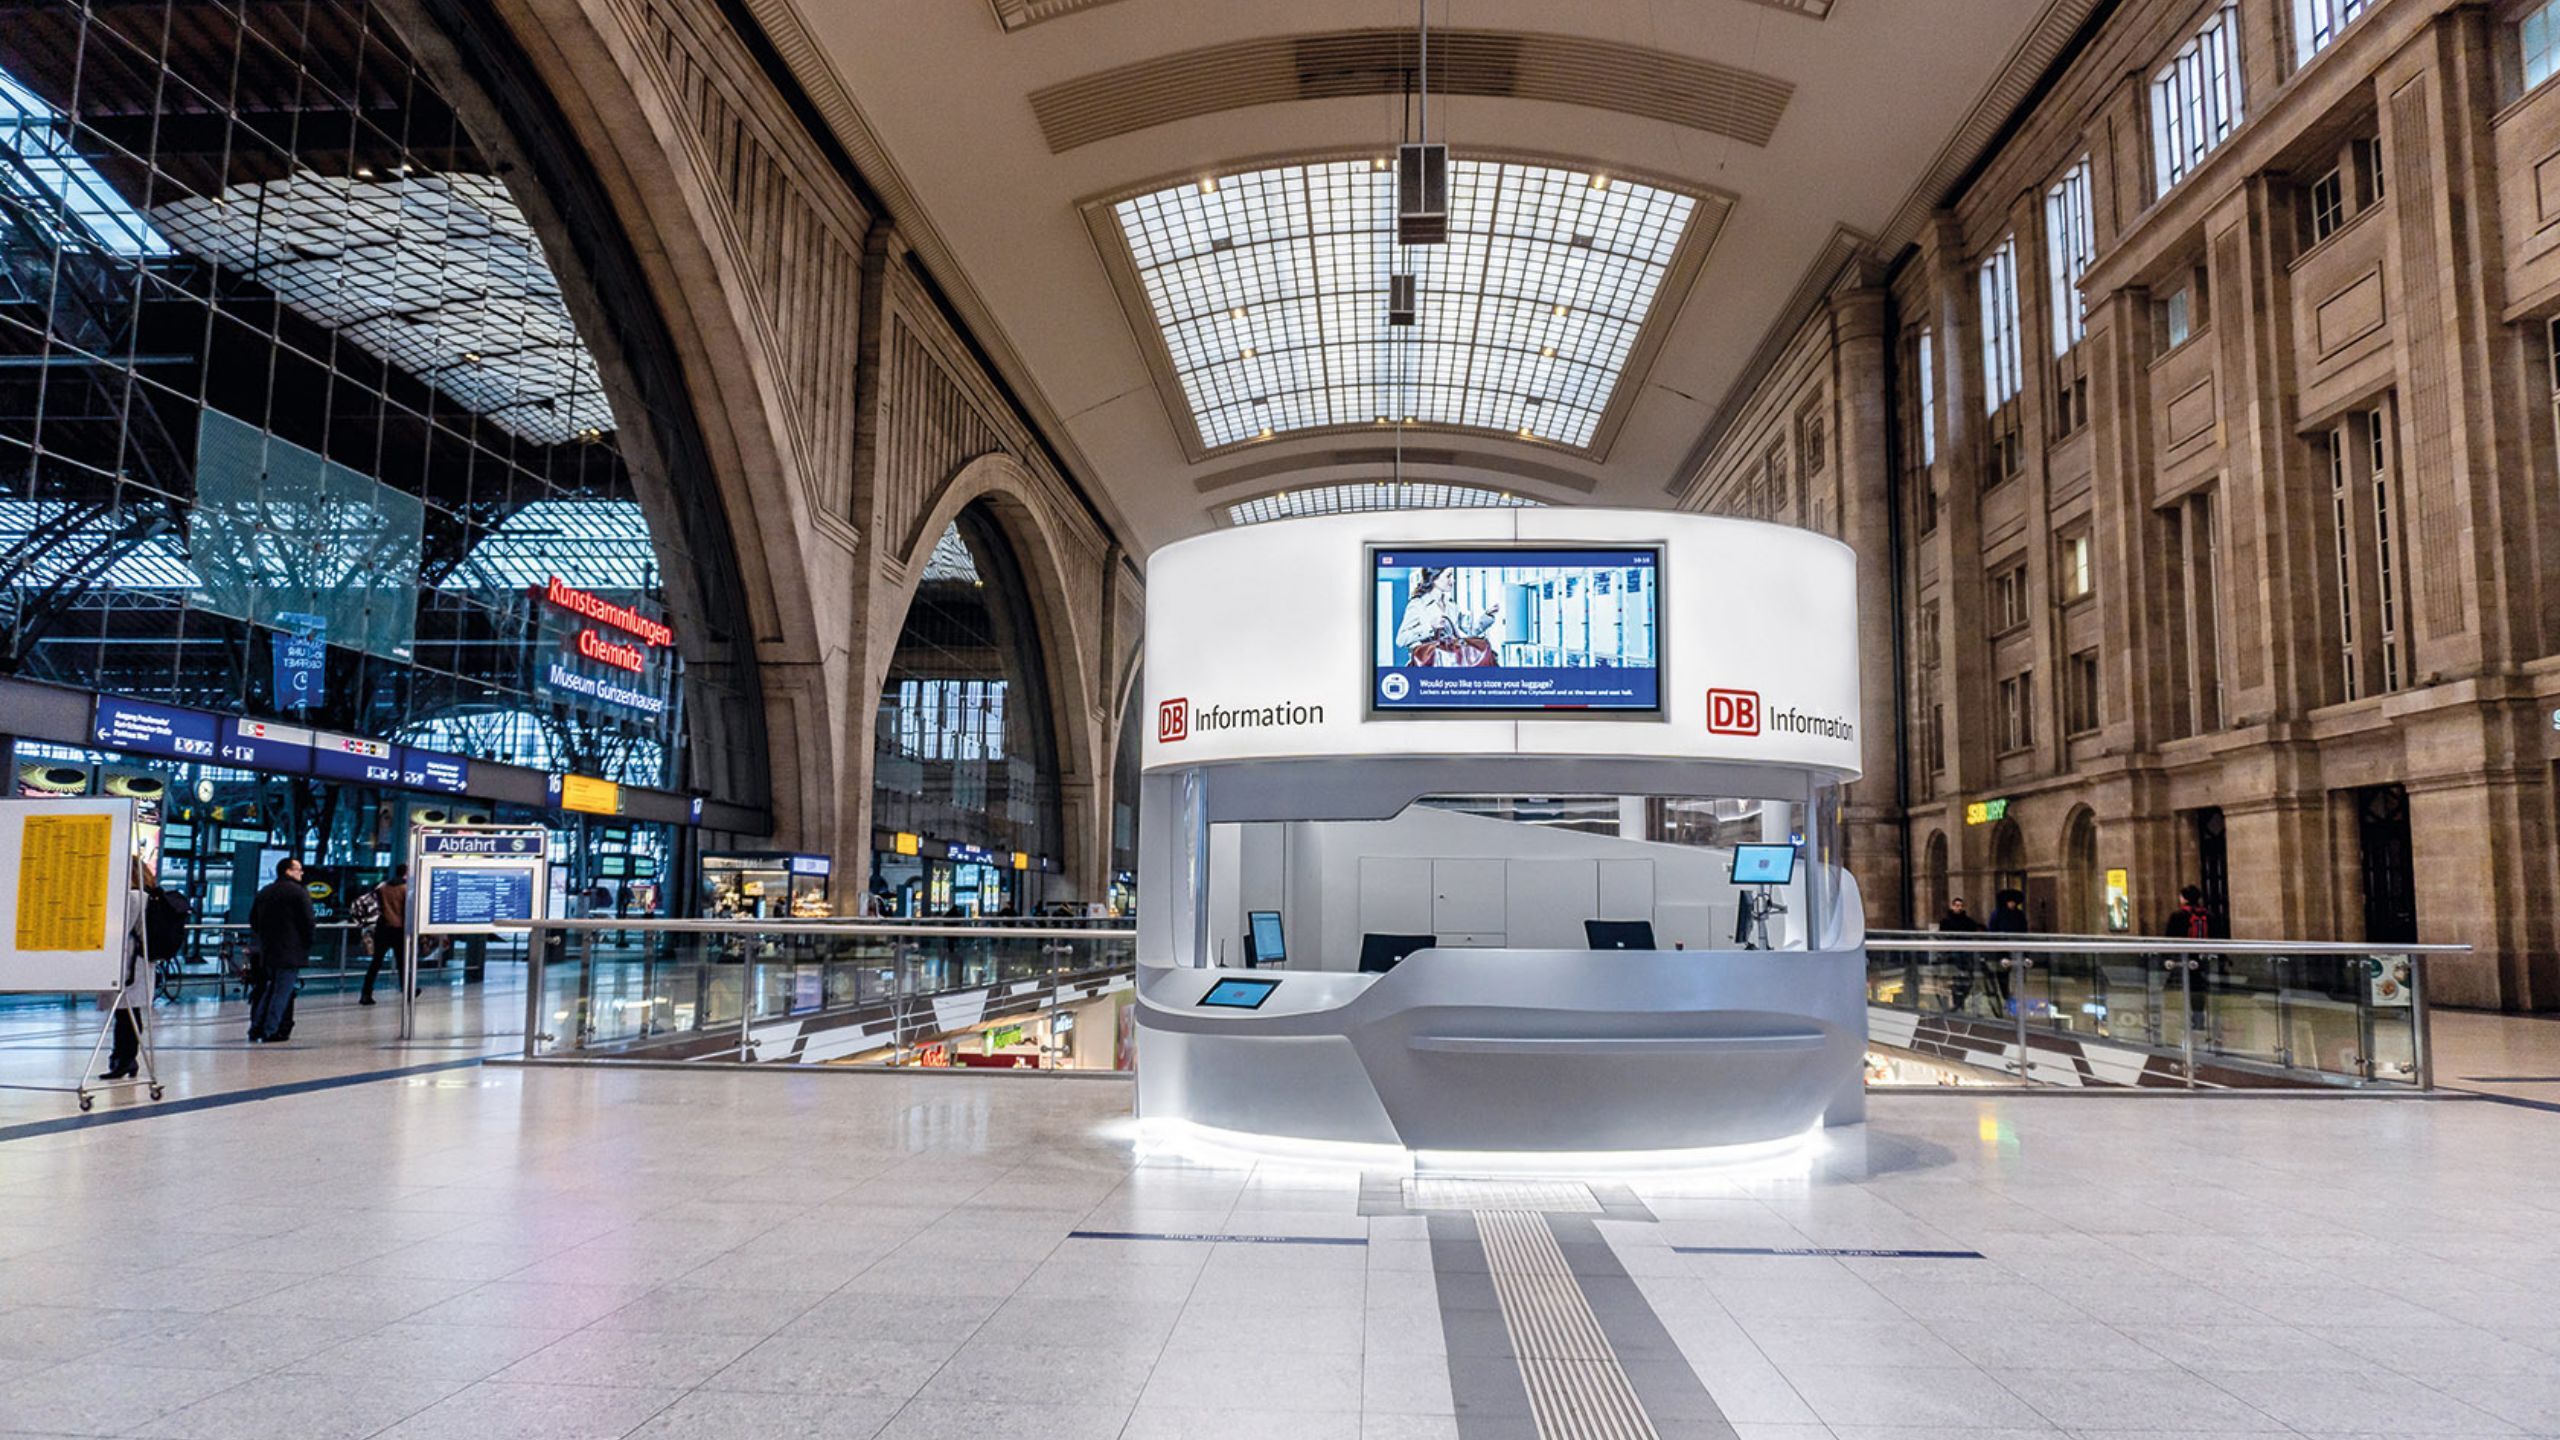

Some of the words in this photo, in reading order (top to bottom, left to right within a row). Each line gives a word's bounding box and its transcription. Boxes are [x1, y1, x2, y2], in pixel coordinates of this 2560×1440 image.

[550, 577, 672, 645] Kunstsammlungen
[580, 629, 644, 672] Chemnitz
[550, 664, 595, 695] Museum
[597, 679, 664, 713] Gunzenhauser
[1419, 679, 1443, 688] Would
[1444, 681, 1458, 689] you
[1459, 679, 1472, 688] like
[1473, 680, 1482, 688] to
[1483, 680, 1502, 688] store
[1503, 681, 1520, 689] your
[1521, 679, 1554, 689] luggage?
[1161, 703, 1185, 736] DB
[1195, 700, 1324, 732] Information
[1713, 695, 1755, 729] DB
[1770, 706, 1854, 742] Information
[549, 773, 562, 793] 16
[1967, 799, 2006, 825] SUBWAY
[438, 838, 496, 852] Abfahrt
